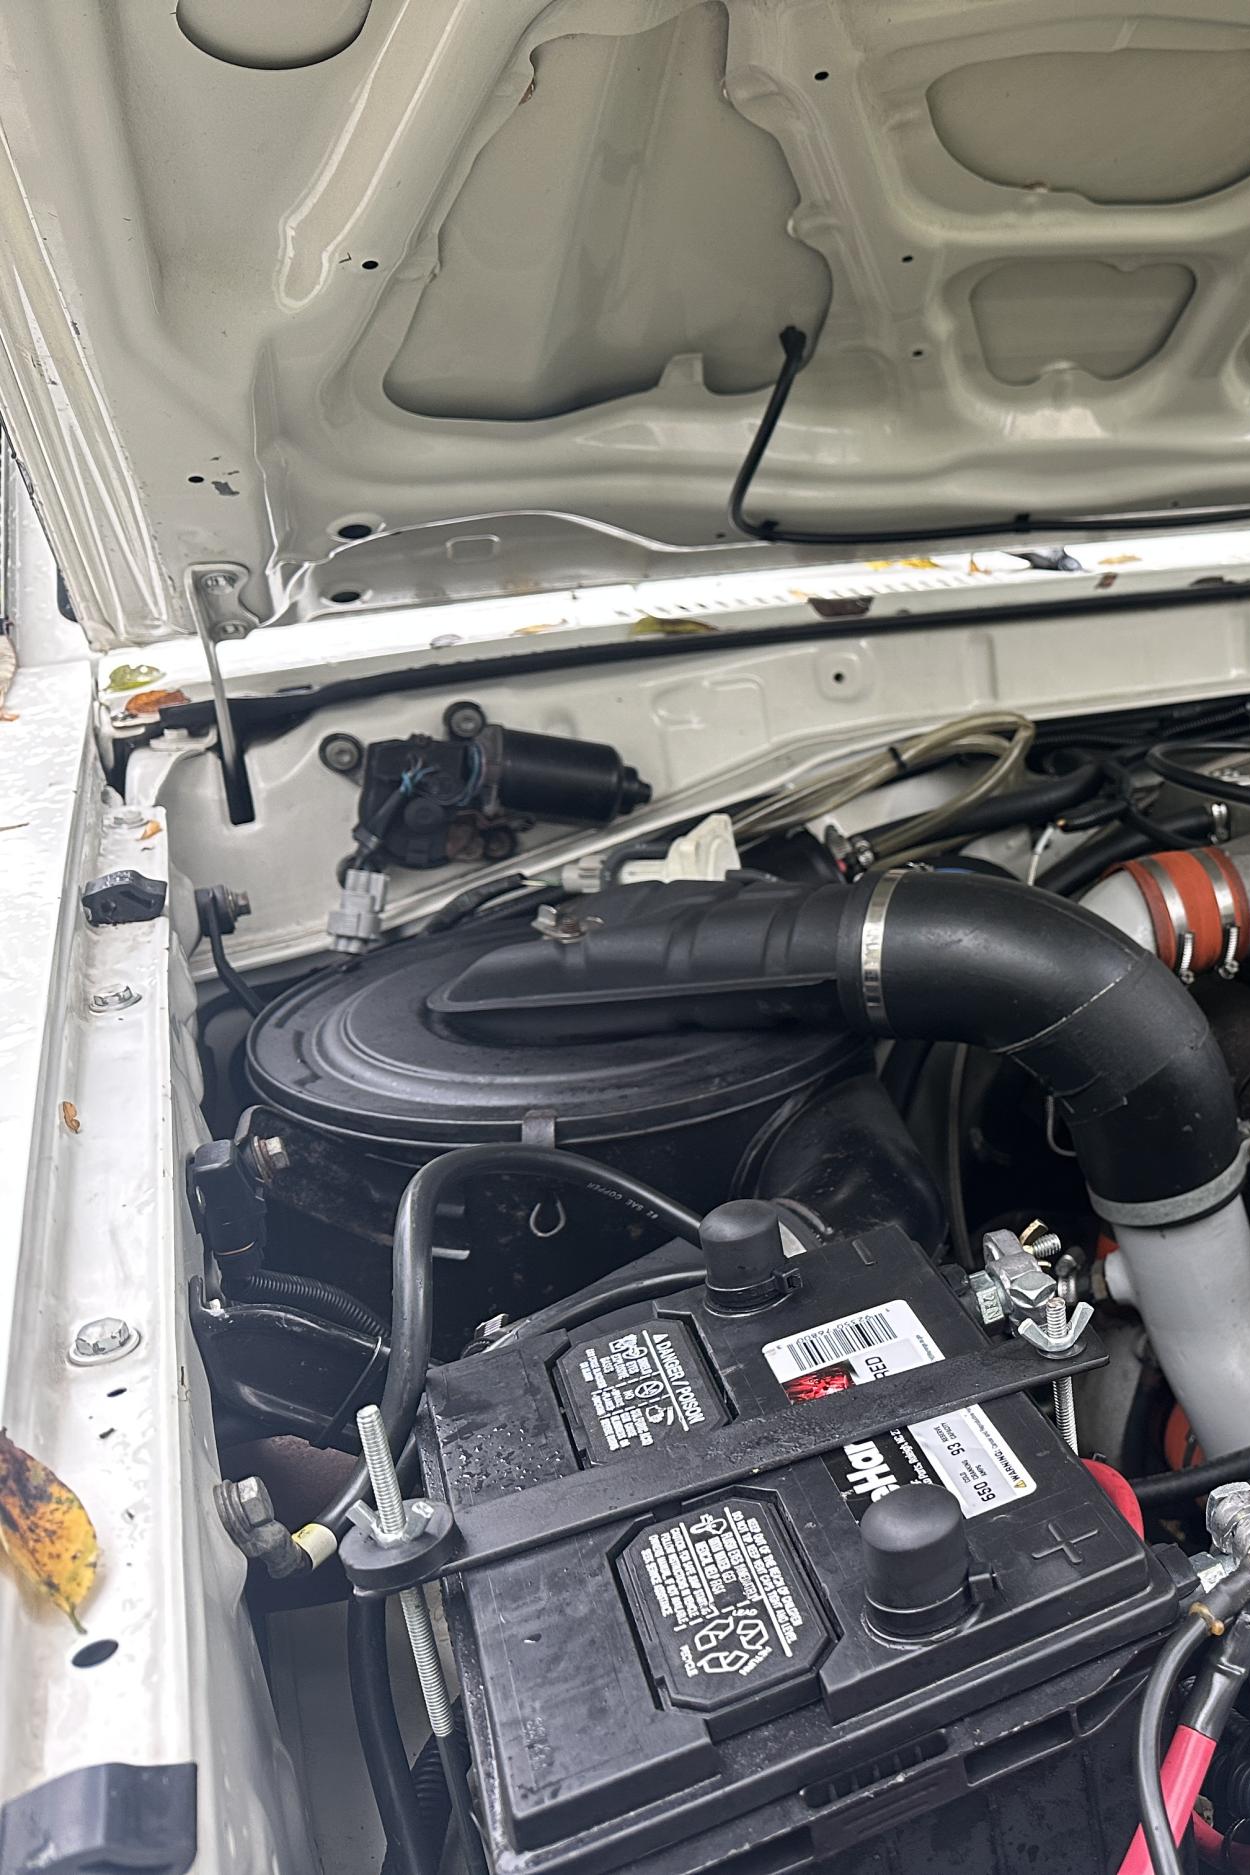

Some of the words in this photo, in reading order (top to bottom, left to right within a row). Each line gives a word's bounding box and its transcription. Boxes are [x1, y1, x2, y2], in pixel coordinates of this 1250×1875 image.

[796, 1328, 832, 1345] 76800
[656, 1341, 685, 1381] DANGER
[676, 1386, 705, 1424] POISON
[623, 1390, 634, 1399] NO
[947, 1442, 966, 1456] 93
[974, 1464, 988, 1476] AMPS
[994, 1448, 1020, 1482] WARNING:
[960, 1472, 971, 1484] COLD
[974, 1481, 996, 1502] 650
[781, 1623, 797, 1644] LEVEL
[680, 1644, 698, 1677] RECYCLE
